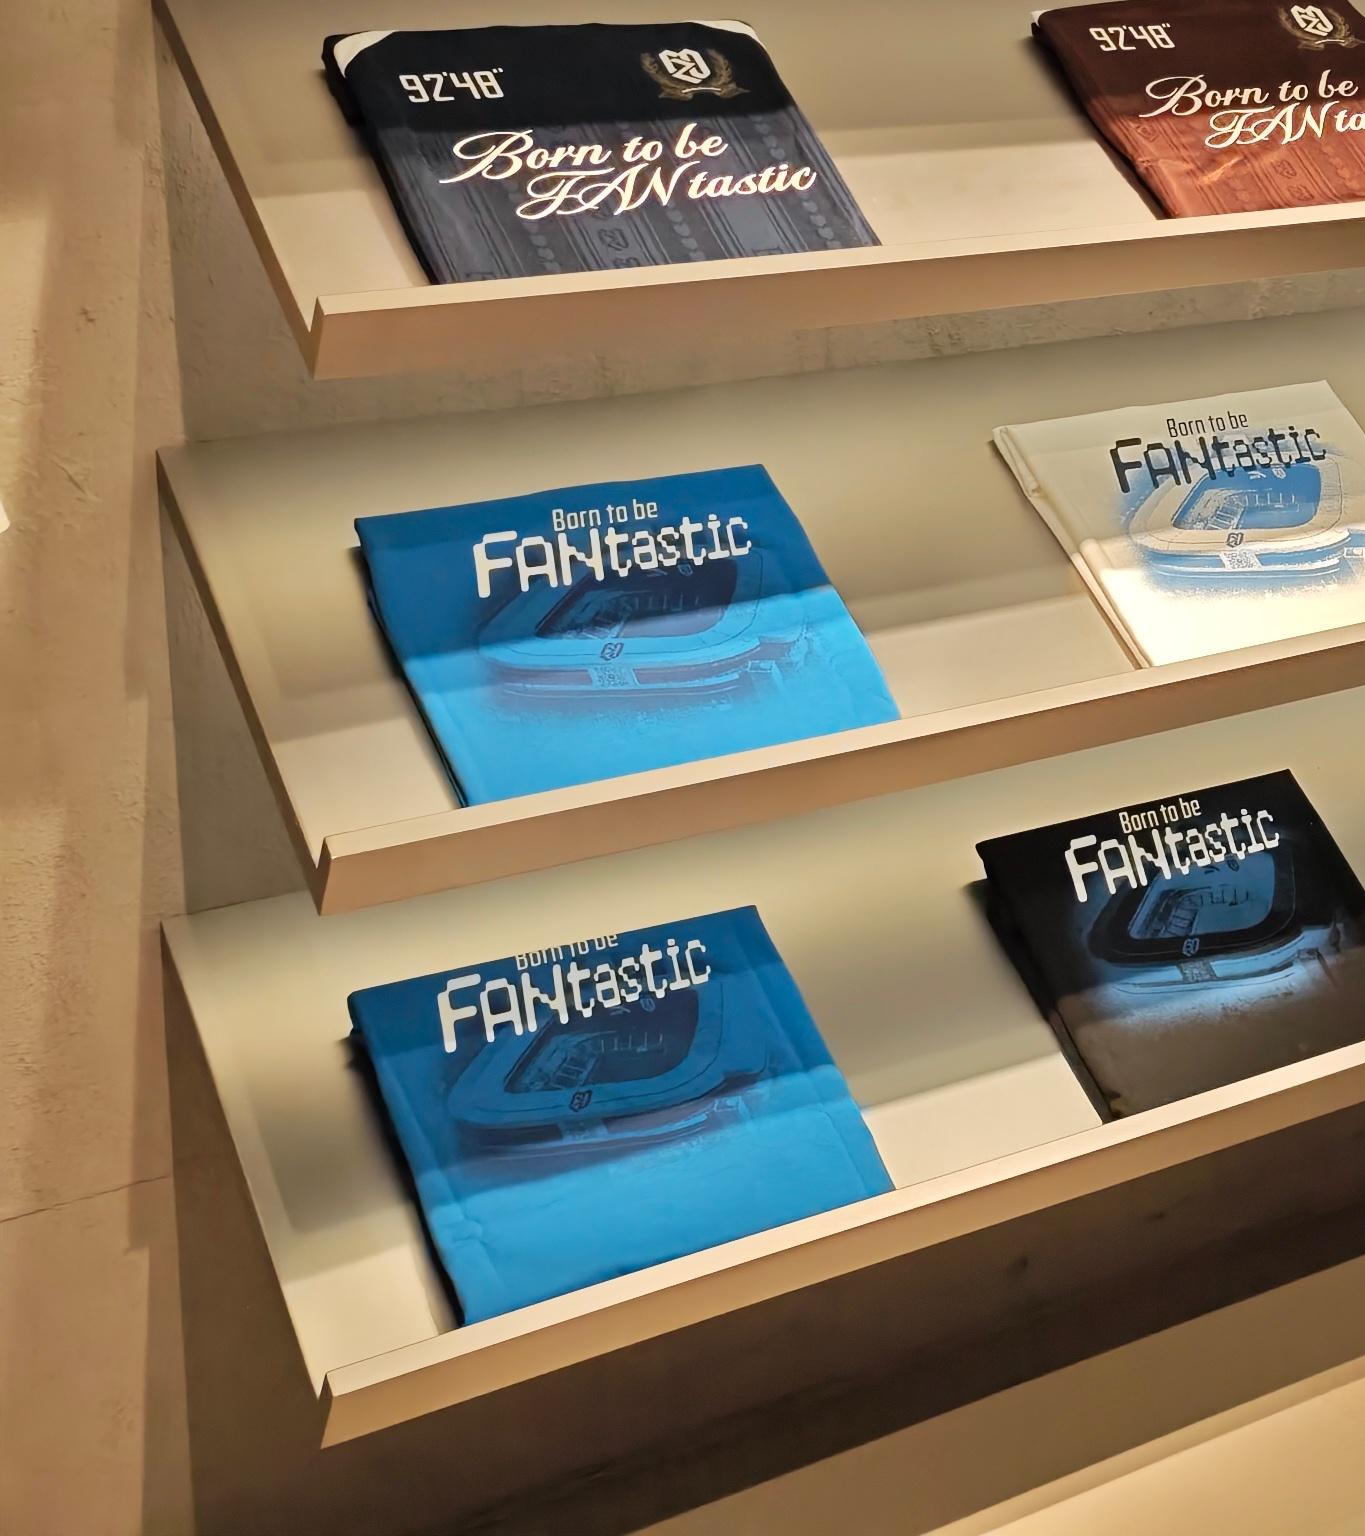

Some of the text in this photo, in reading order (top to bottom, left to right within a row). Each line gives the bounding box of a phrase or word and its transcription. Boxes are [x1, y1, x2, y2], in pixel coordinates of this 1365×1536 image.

[1138, 69, 1359, 119] Born to be
[439, 123, 729, 185] Born to be
[515, 161, 819, 221] FANtastic
[1166, 410, 1250, 439] Born to be
[1109, 424, 1328, 494] FANtastic
[551, 498, 659, 533] Born to be
[472, 513, 753, 599] FANtastic
[1118, 797, 1203, 835] Born to be
[1064, 807, 1281, 903] FANtastic
[437, 937, 712, 1054] FANtastic
